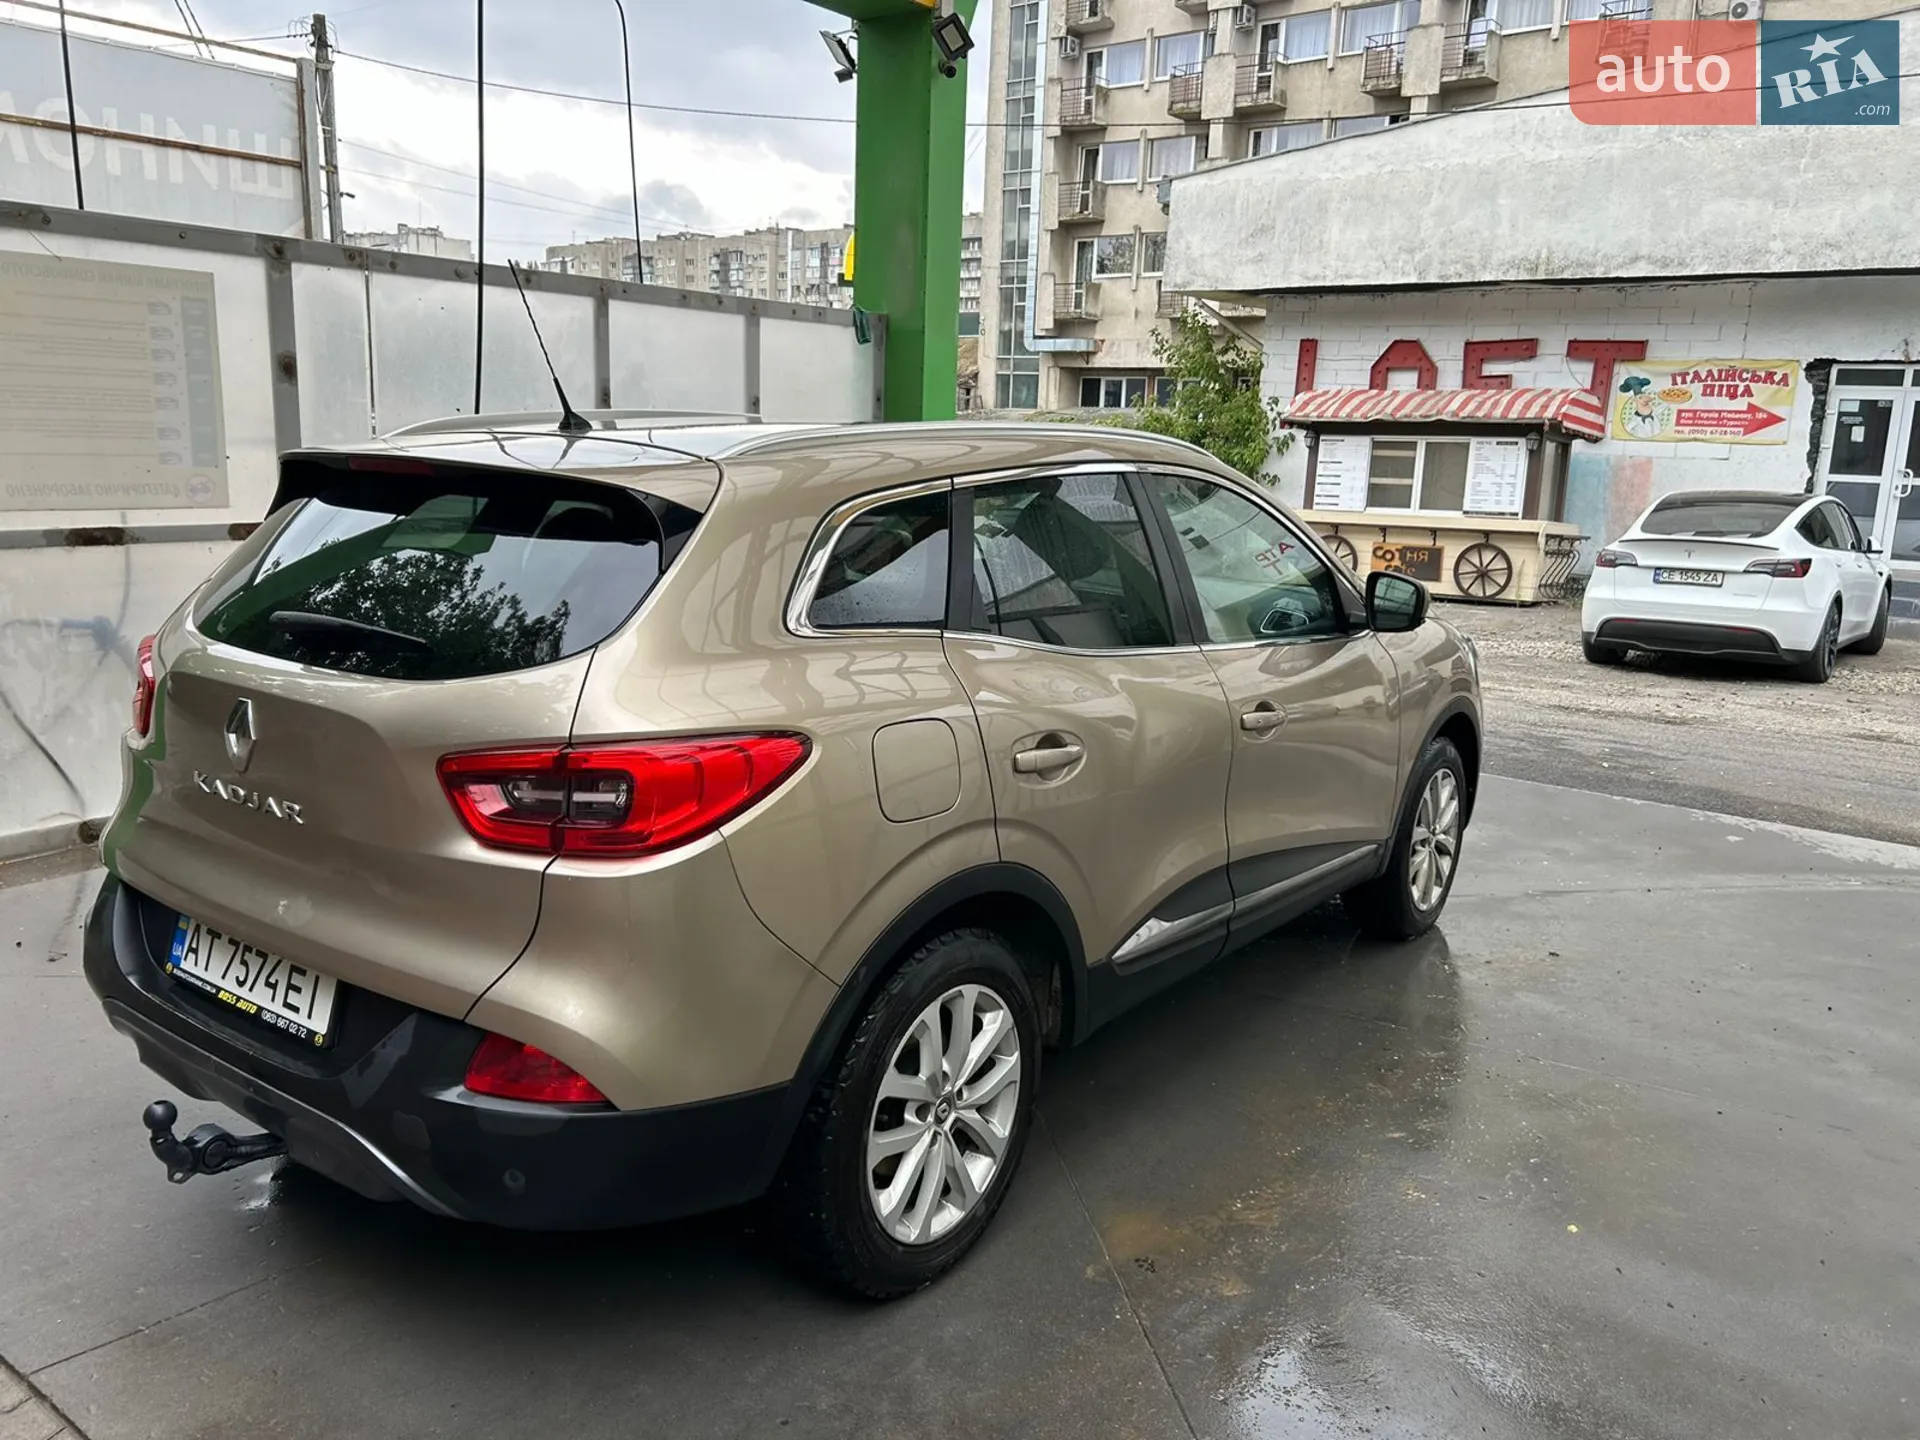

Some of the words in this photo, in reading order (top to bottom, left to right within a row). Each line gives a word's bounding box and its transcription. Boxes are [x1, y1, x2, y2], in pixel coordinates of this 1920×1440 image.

[1670, 365, 1790, 387] ІТАЛІЙСЬКА
[1701, 383, 1755, 400] ПІЦА
[1660, 569, 1676, 581] CE
[1679, 570, 1702, 582] 1545
[1703, 571, 1719, 583] ZA
[193, 768, 304, 825] KADJAR
[183, 922, 222, 972] AT
